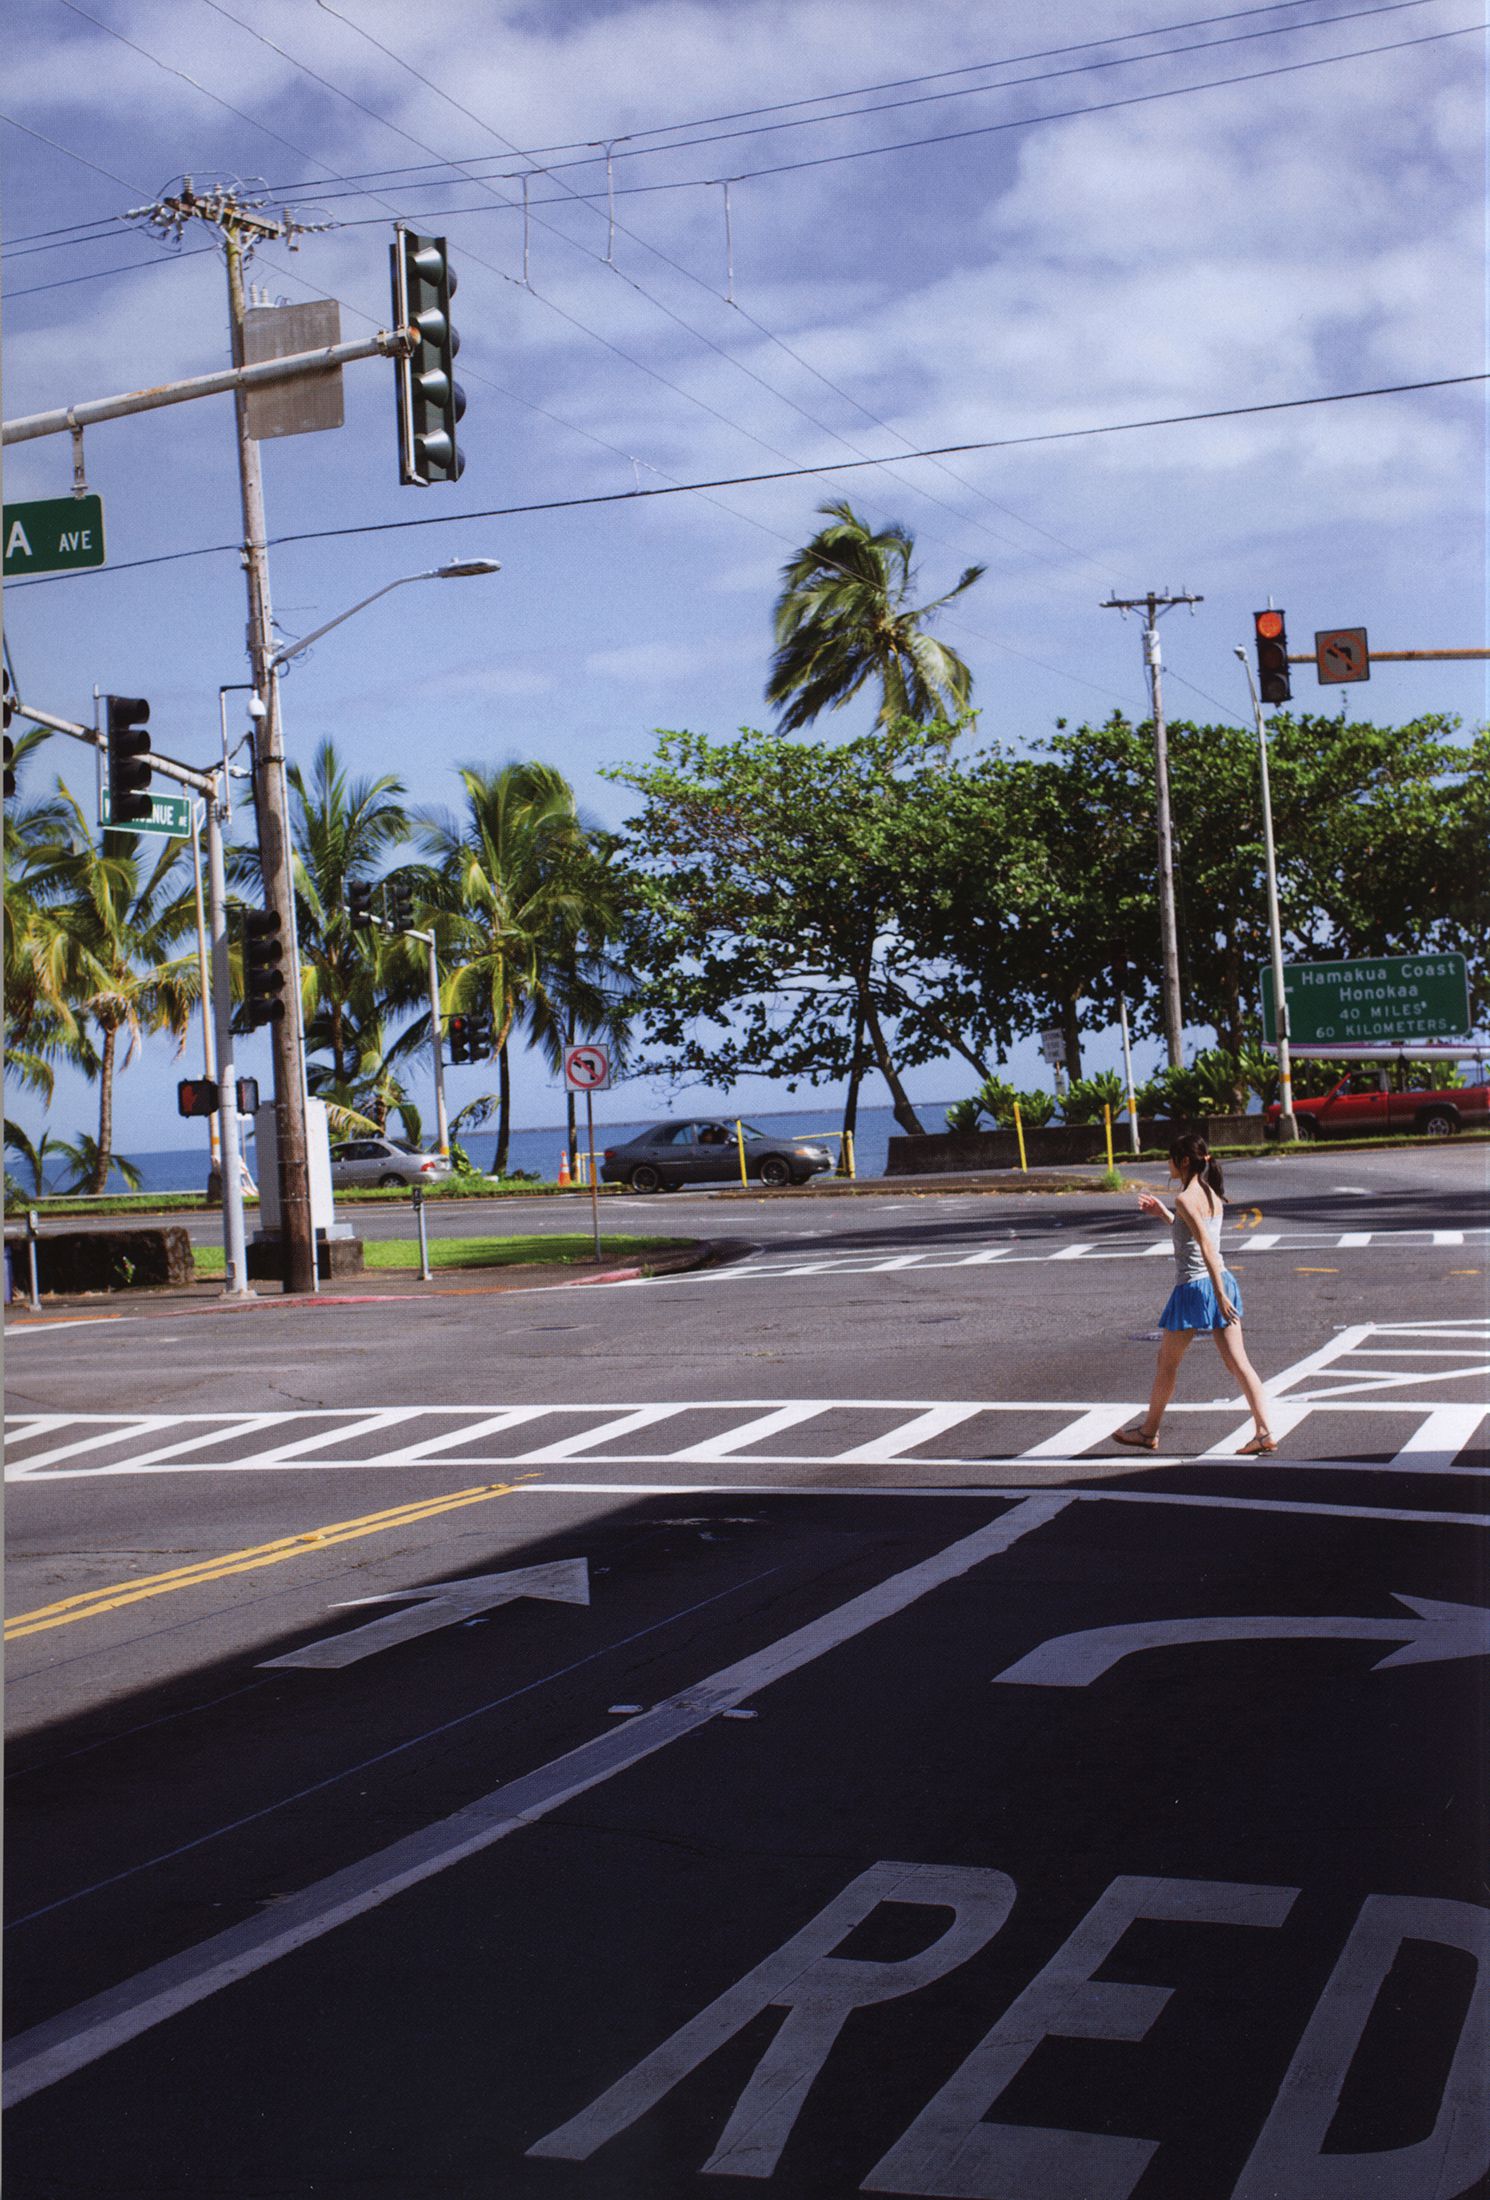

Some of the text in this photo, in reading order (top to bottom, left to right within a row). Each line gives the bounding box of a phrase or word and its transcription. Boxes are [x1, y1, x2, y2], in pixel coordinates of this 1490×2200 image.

[59, 530, 92, 552] AVE
[1302, 961, 1456, 985] Hamakua Coast
[1340, 985, 1418, 1001] Honokaa
[1340, 1003, 1422, 1019] 40 MILES
[1316, 1018, 1447, 1038] 60 KILOMETERS
[524, 1860, 1490, 2200] RED
